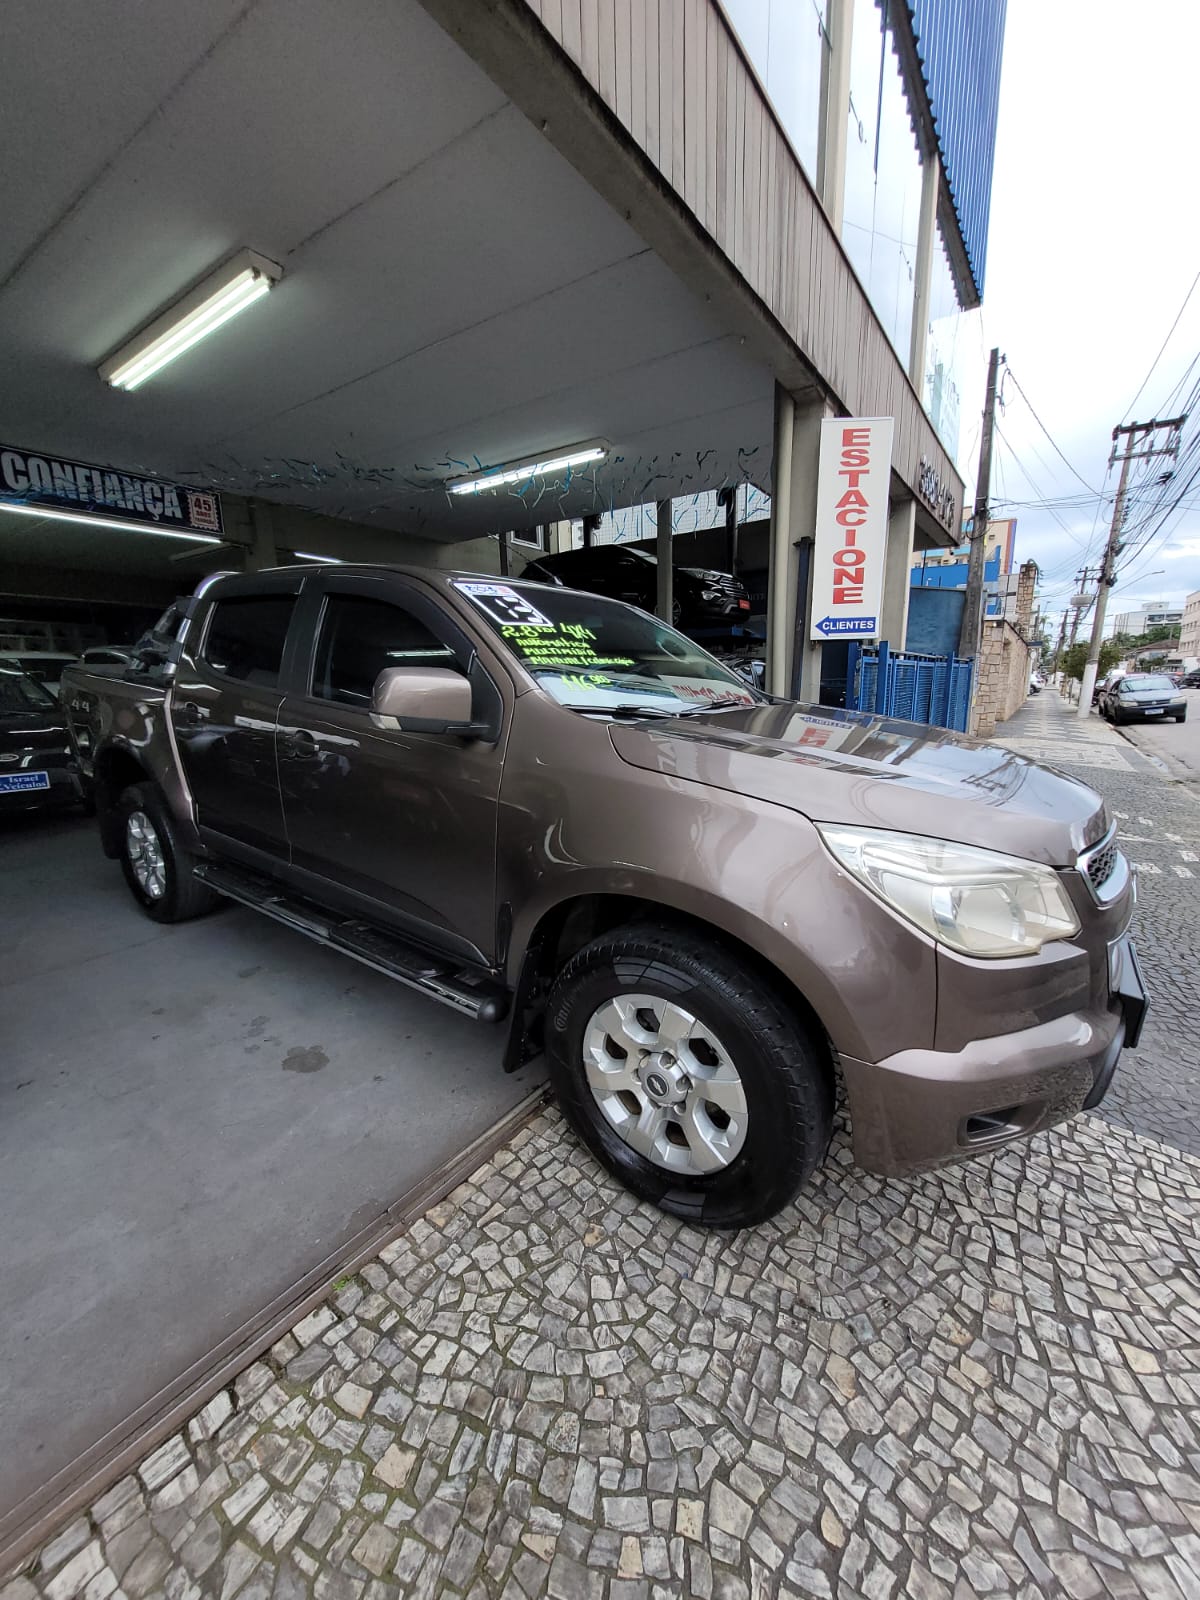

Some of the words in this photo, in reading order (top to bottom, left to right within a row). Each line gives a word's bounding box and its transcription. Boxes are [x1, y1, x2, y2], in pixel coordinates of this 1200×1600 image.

[1, 452, 183, 520] CONFIANÇA
[194, 497, 211, 511] 45
[832, 428, 871, 605] ESTACIONE
[822, 620, 874, 631] CLIENTES
